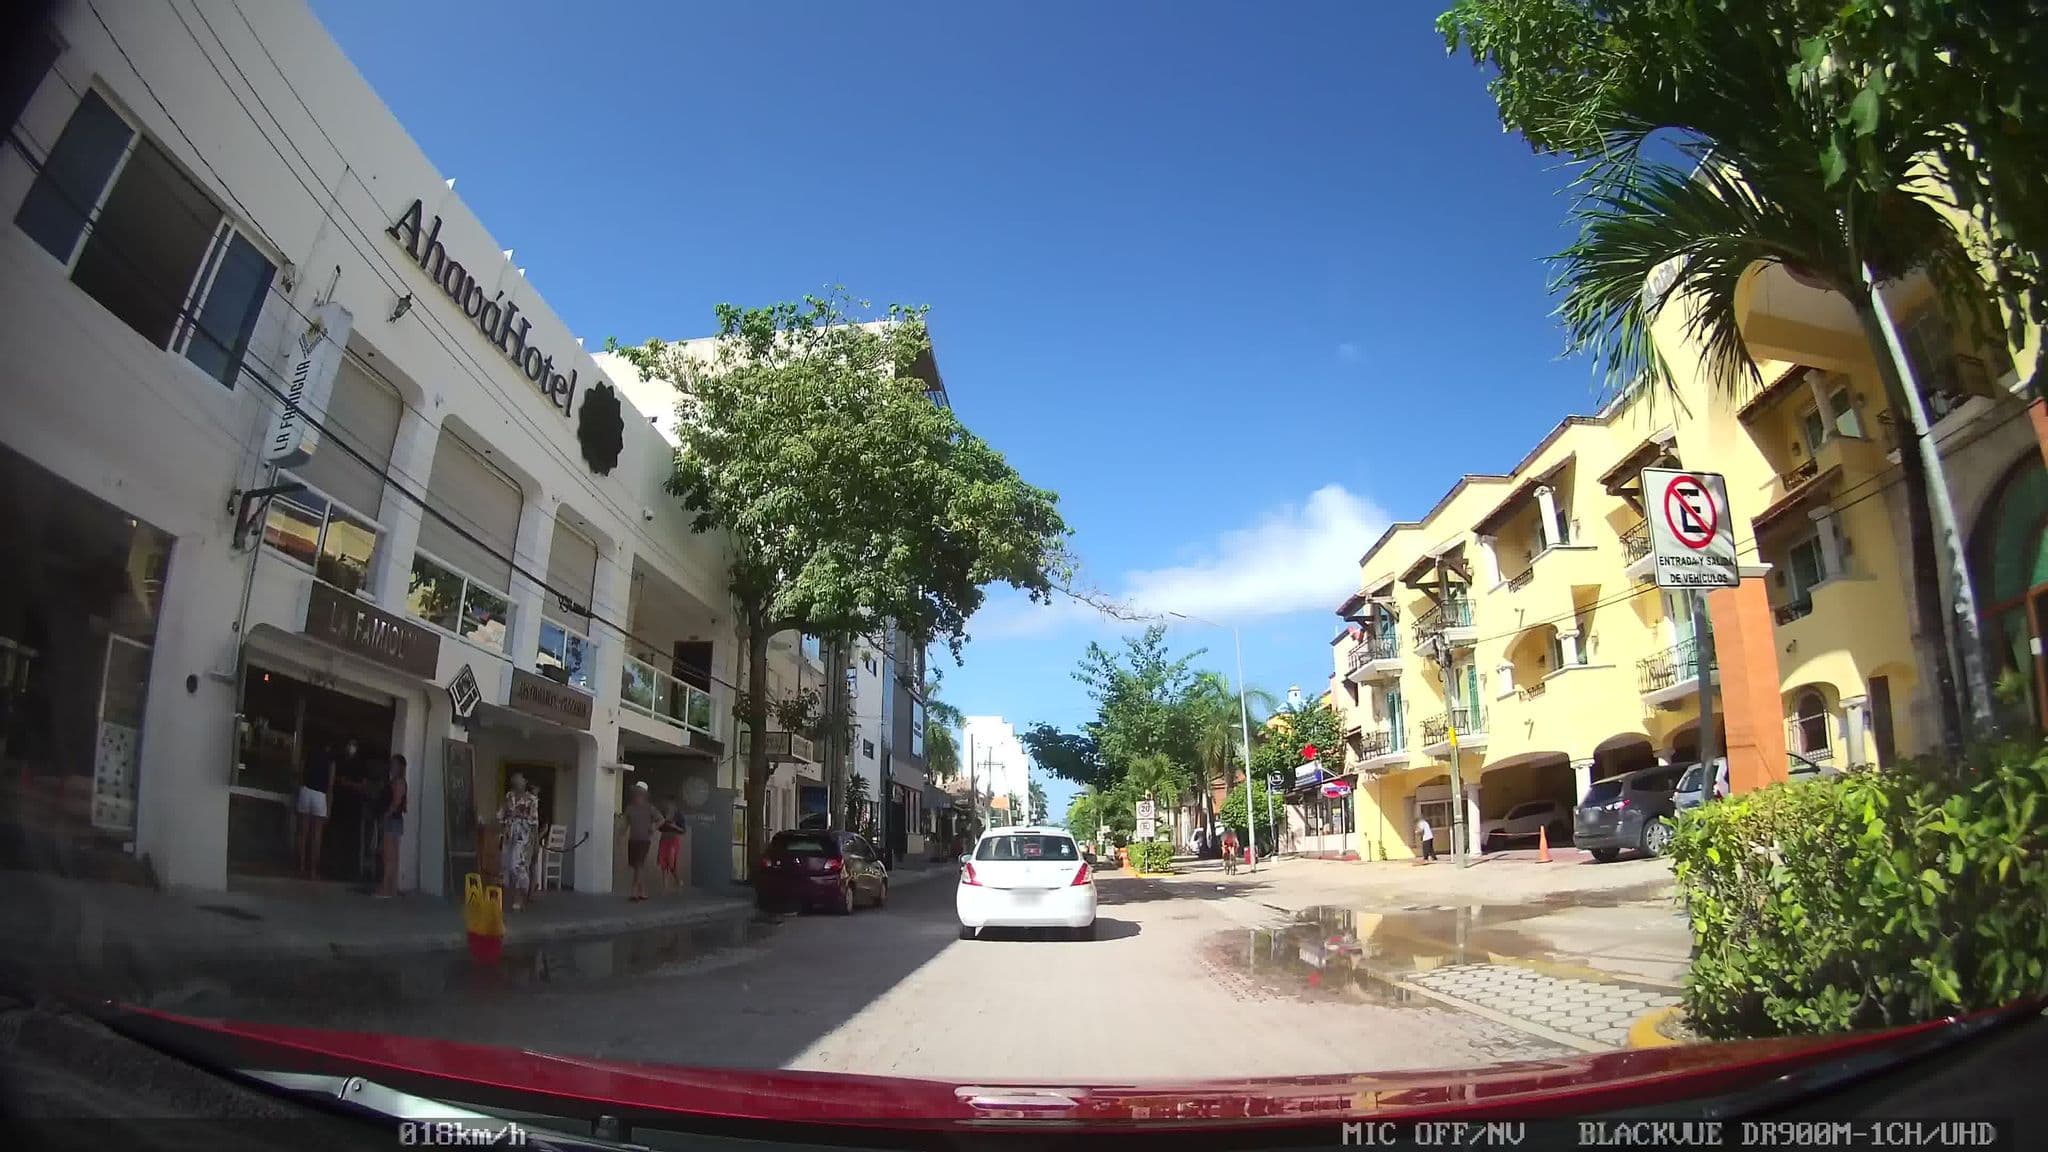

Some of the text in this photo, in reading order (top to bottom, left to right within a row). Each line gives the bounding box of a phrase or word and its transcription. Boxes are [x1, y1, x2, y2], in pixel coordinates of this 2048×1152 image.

[273, 431, 291, 452] LA
[1659, 555, 1697, 567] ENTRADA
[1670, 573, 1682, 584] DE
